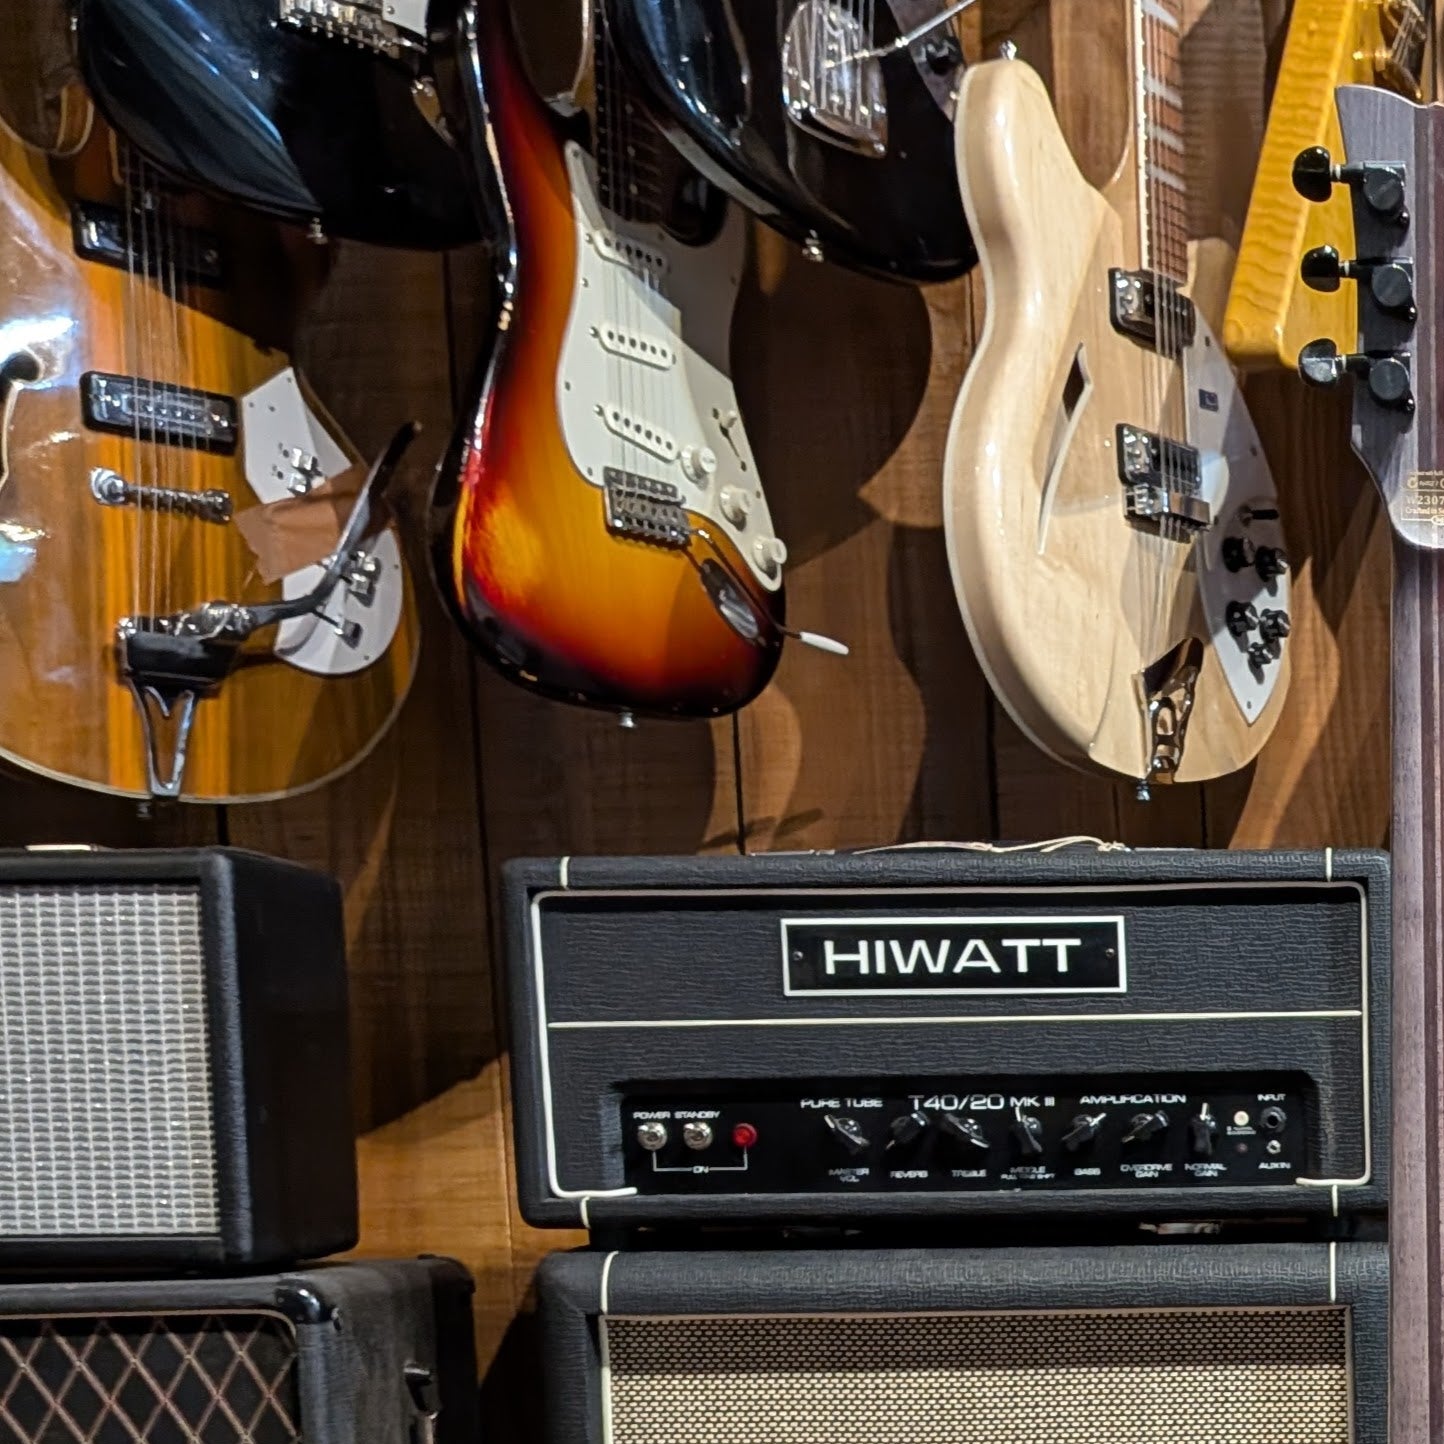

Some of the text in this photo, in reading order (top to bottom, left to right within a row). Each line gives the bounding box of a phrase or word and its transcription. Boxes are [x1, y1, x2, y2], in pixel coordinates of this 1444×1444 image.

[824, 937, 1082, 975] HIWATT
[1257, 1093, 1286, 1101] INPUT
[800, 1098, 841, 1108] PURE
[845, 1098, 883, 1108] TUBE
[908, 1093, 1005, 1111] T40/20
[1010, 1096, 1041, 1107] MK
[1079, 1094, 1187, 1104] AMPLIFICATION
[633, 1110, 721, 1120] POWER STANDBY
[692, 1165, 709, 1174] ON
[1120, 1163, 1173, 1172] OVERDRIVE
[1184, 1163, 1227, 1171] NORMAL
[890, 1170, 929, 1178] REVERB
